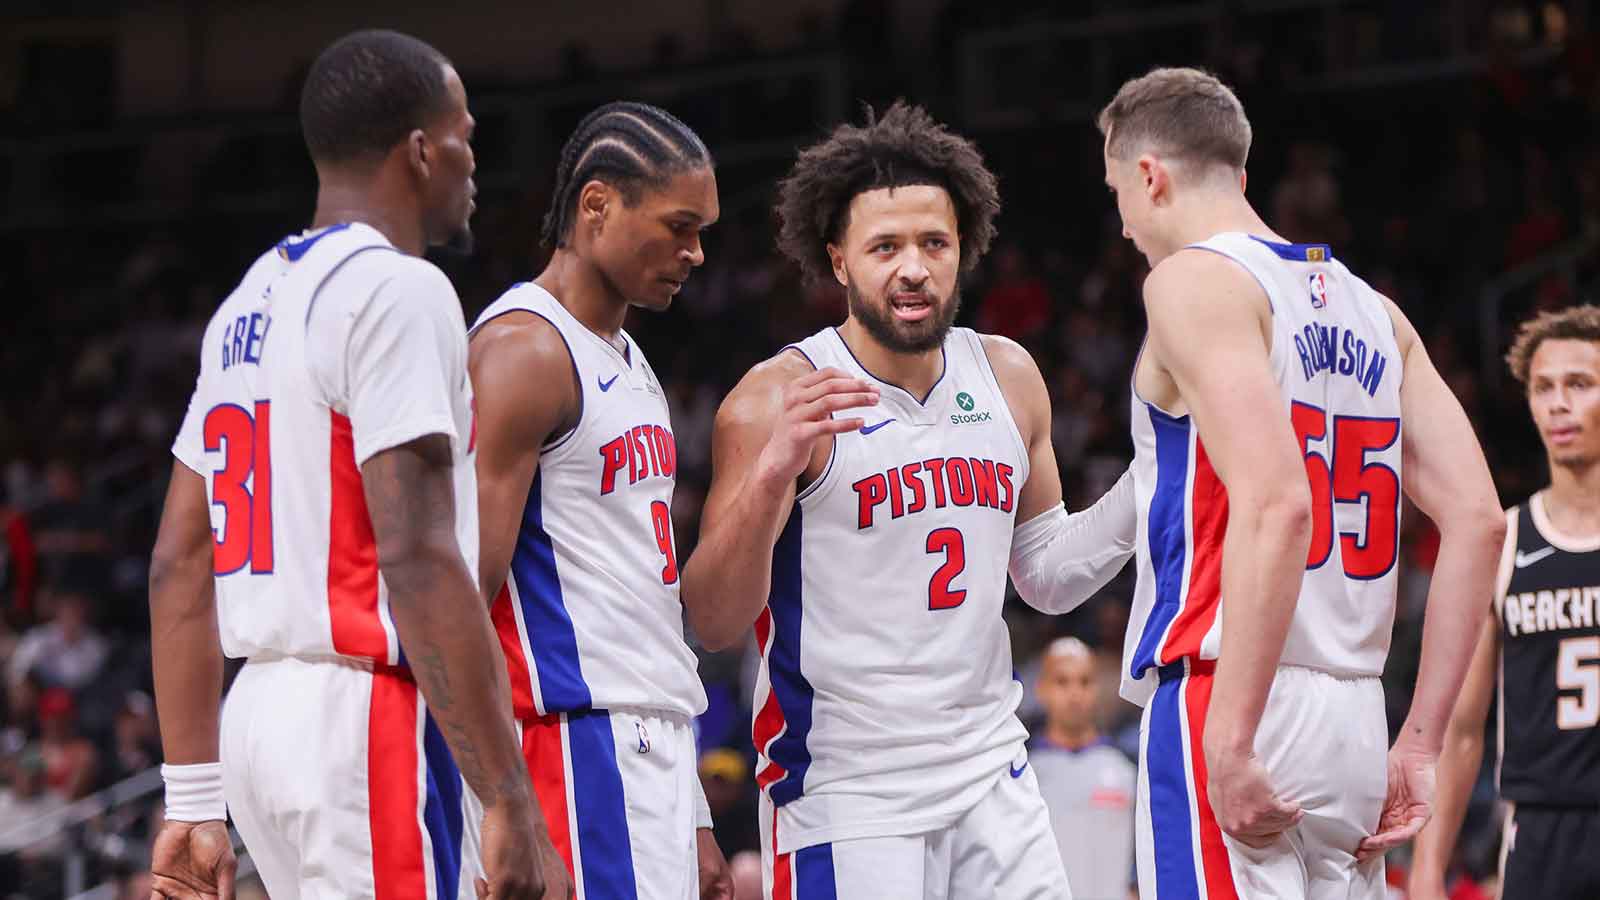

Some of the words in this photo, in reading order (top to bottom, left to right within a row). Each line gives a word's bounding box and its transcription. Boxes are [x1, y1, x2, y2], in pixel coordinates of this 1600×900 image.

[950, 411, 992, 425] StockX
[203, 398, 274, 576] 31
[852, 457, 1014, 530] PISTONS
[1290, 399, 1400, 580] 55
[650, 500, 678, 585] 9
[925, 527, 967, 611] 2
[1556, 636, 1600, 730] 5
